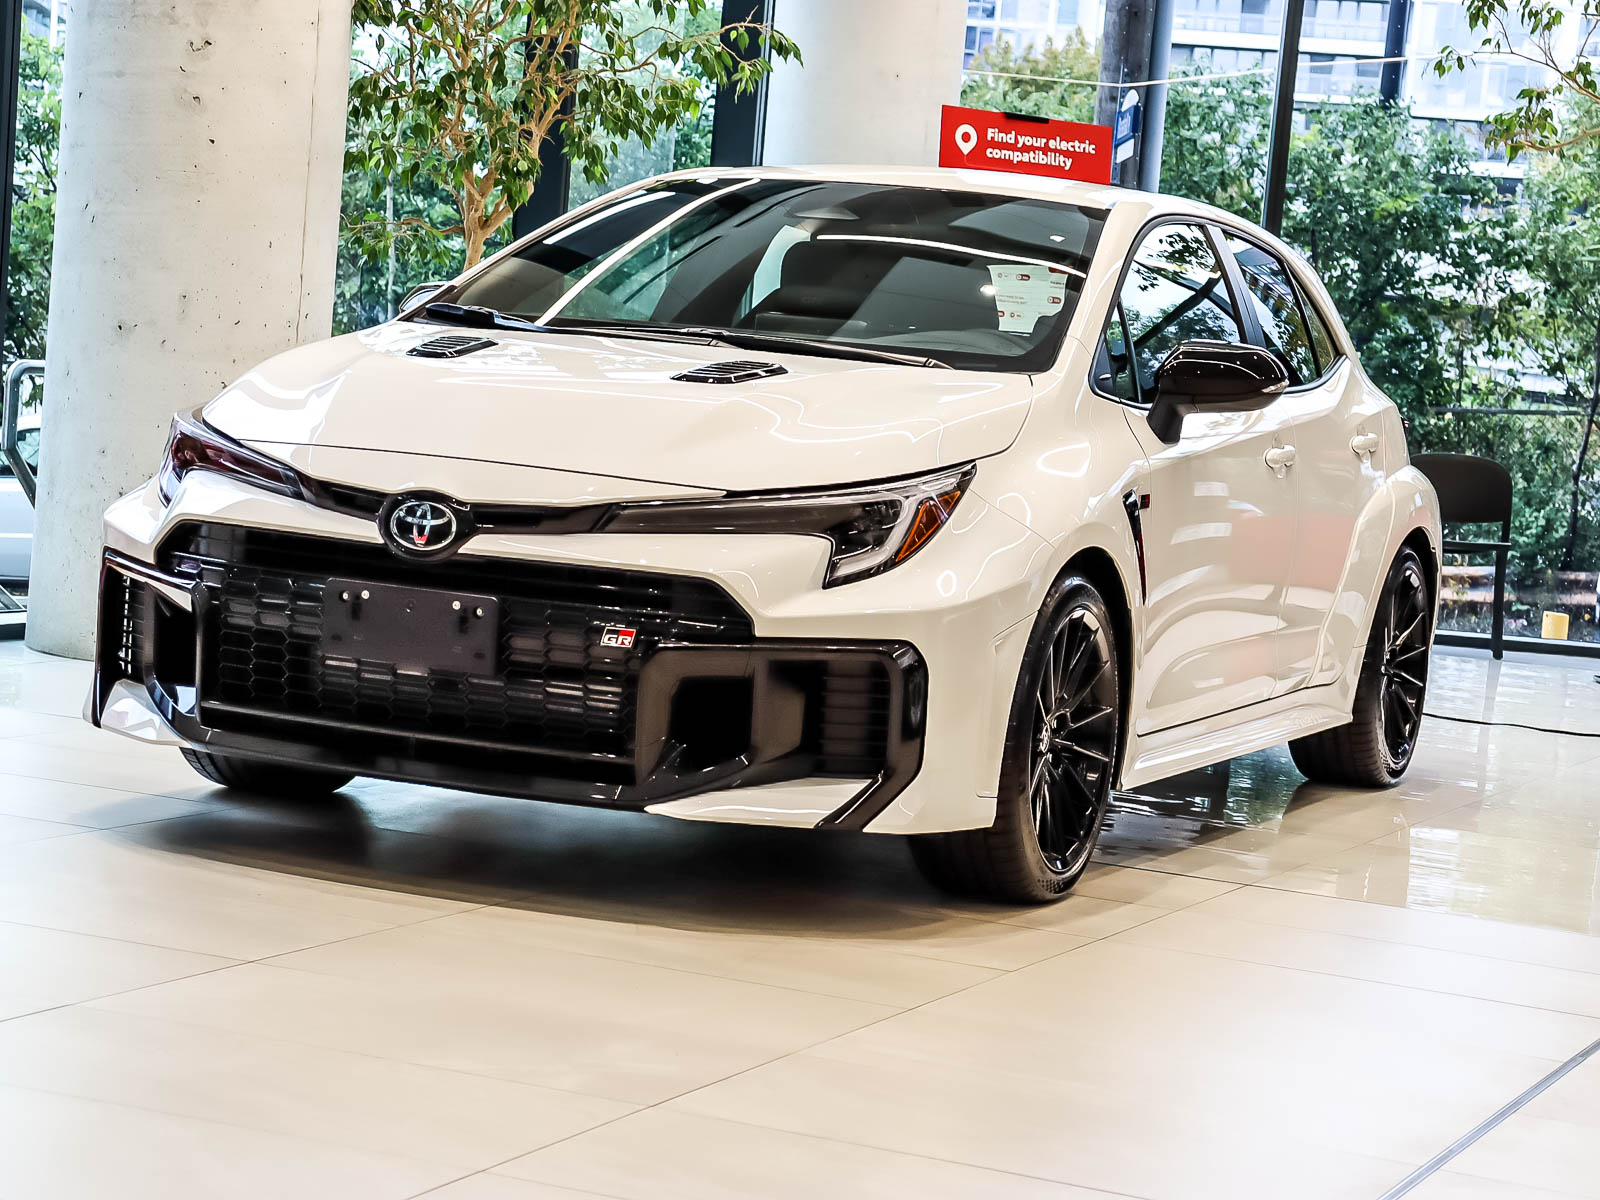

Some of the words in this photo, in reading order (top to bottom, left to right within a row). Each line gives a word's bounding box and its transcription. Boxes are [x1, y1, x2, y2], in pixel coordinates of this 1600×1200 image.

[987, 127, 1015, 144] Find
[1016, 134, 1047, 148] your
[1048, 136, 1096, 154] electric
[985, 147, 1073, 171] compatibility
[603, 634, 632, 646] GR
